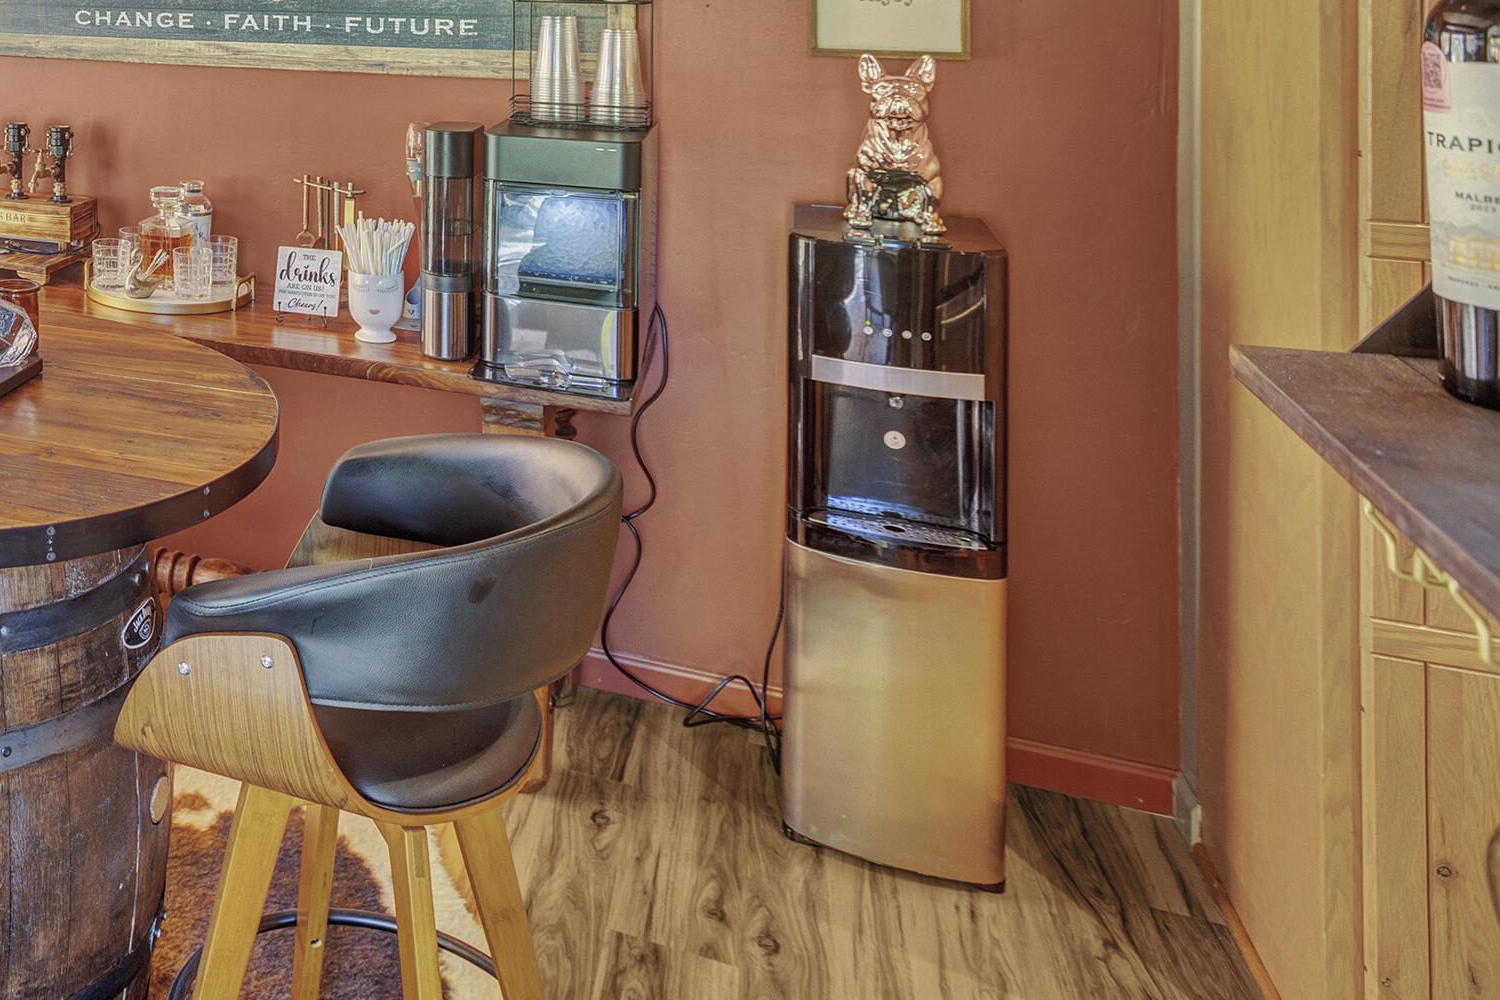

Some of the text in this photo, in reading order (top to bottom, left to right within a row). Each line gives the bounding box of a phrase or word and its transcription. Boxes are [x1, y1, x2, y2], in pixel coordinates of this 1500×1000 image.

[75, 9, 479, 37] CHANGE FAITH FUTURE
[1427, 130, 1500, 155] TRAPI
[6, 212, 26, 224] BAR
[280, 251, 337, 287] drinks
[286, 282, 300, 290] ARE
[301, 283, 312, 291] ON
[287, 297, 324, 311] Cheers!
